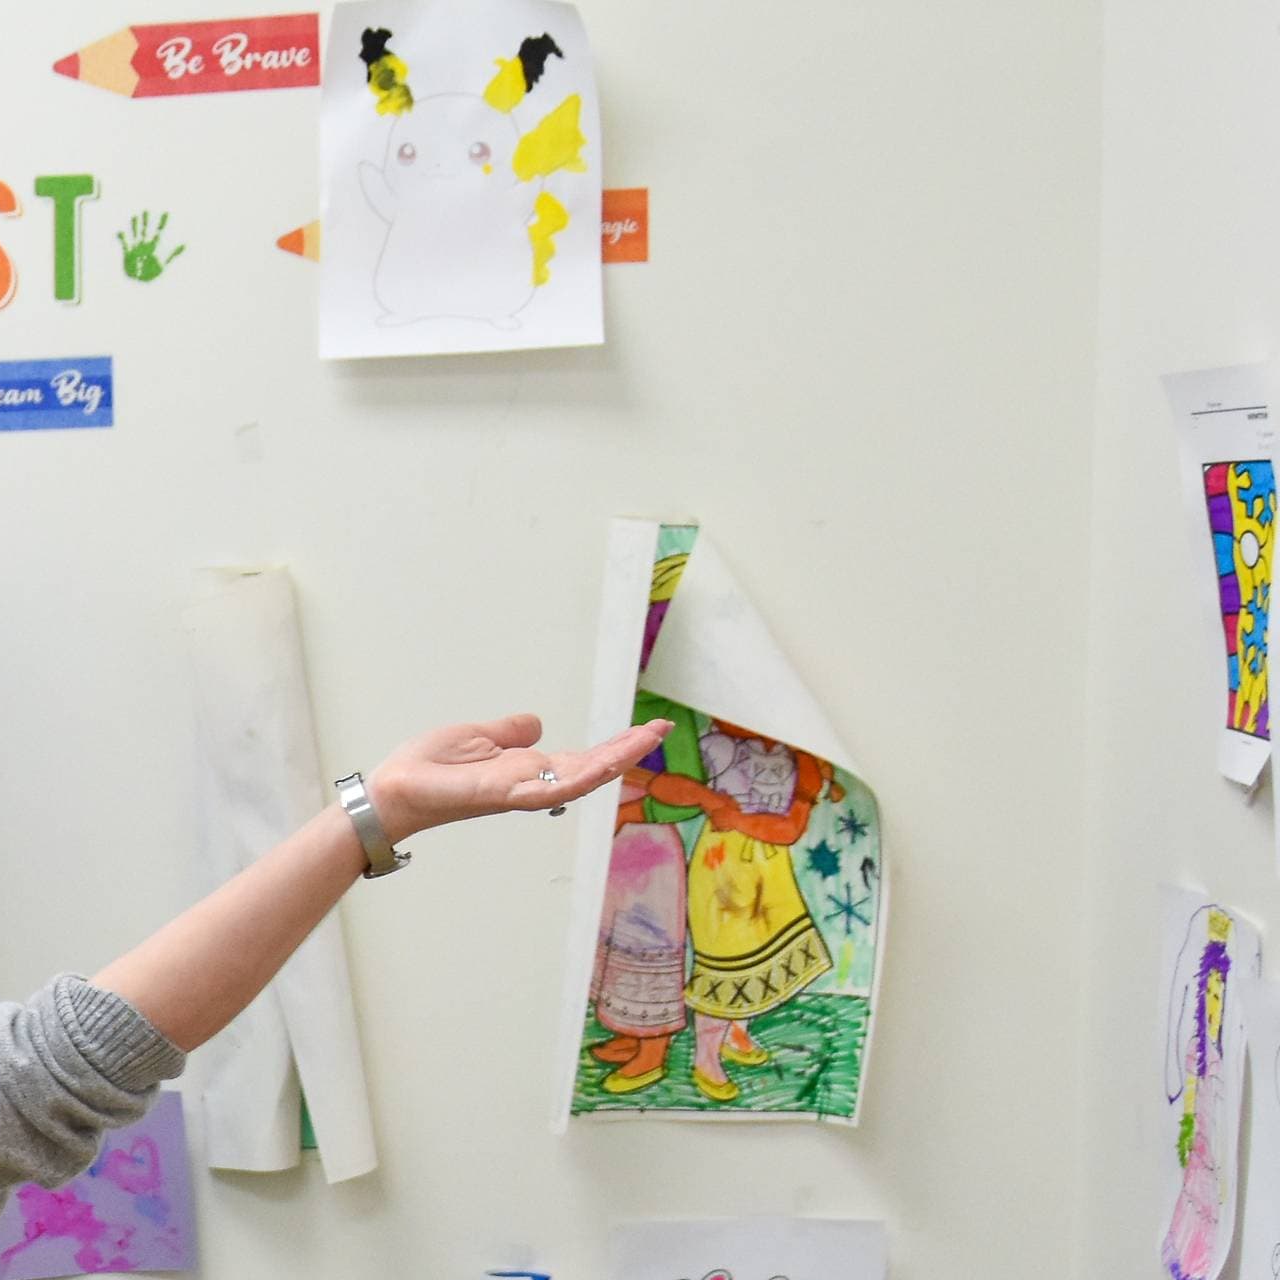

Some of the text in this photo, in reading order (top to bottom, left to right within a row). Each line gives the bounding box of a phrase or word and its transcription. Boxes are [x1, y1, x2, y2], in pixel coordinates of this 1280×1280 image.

[156, 33, 312, 79] Be Brave
[602, 214, 639, 247] agic
[50, 370, 104, 415] Big
